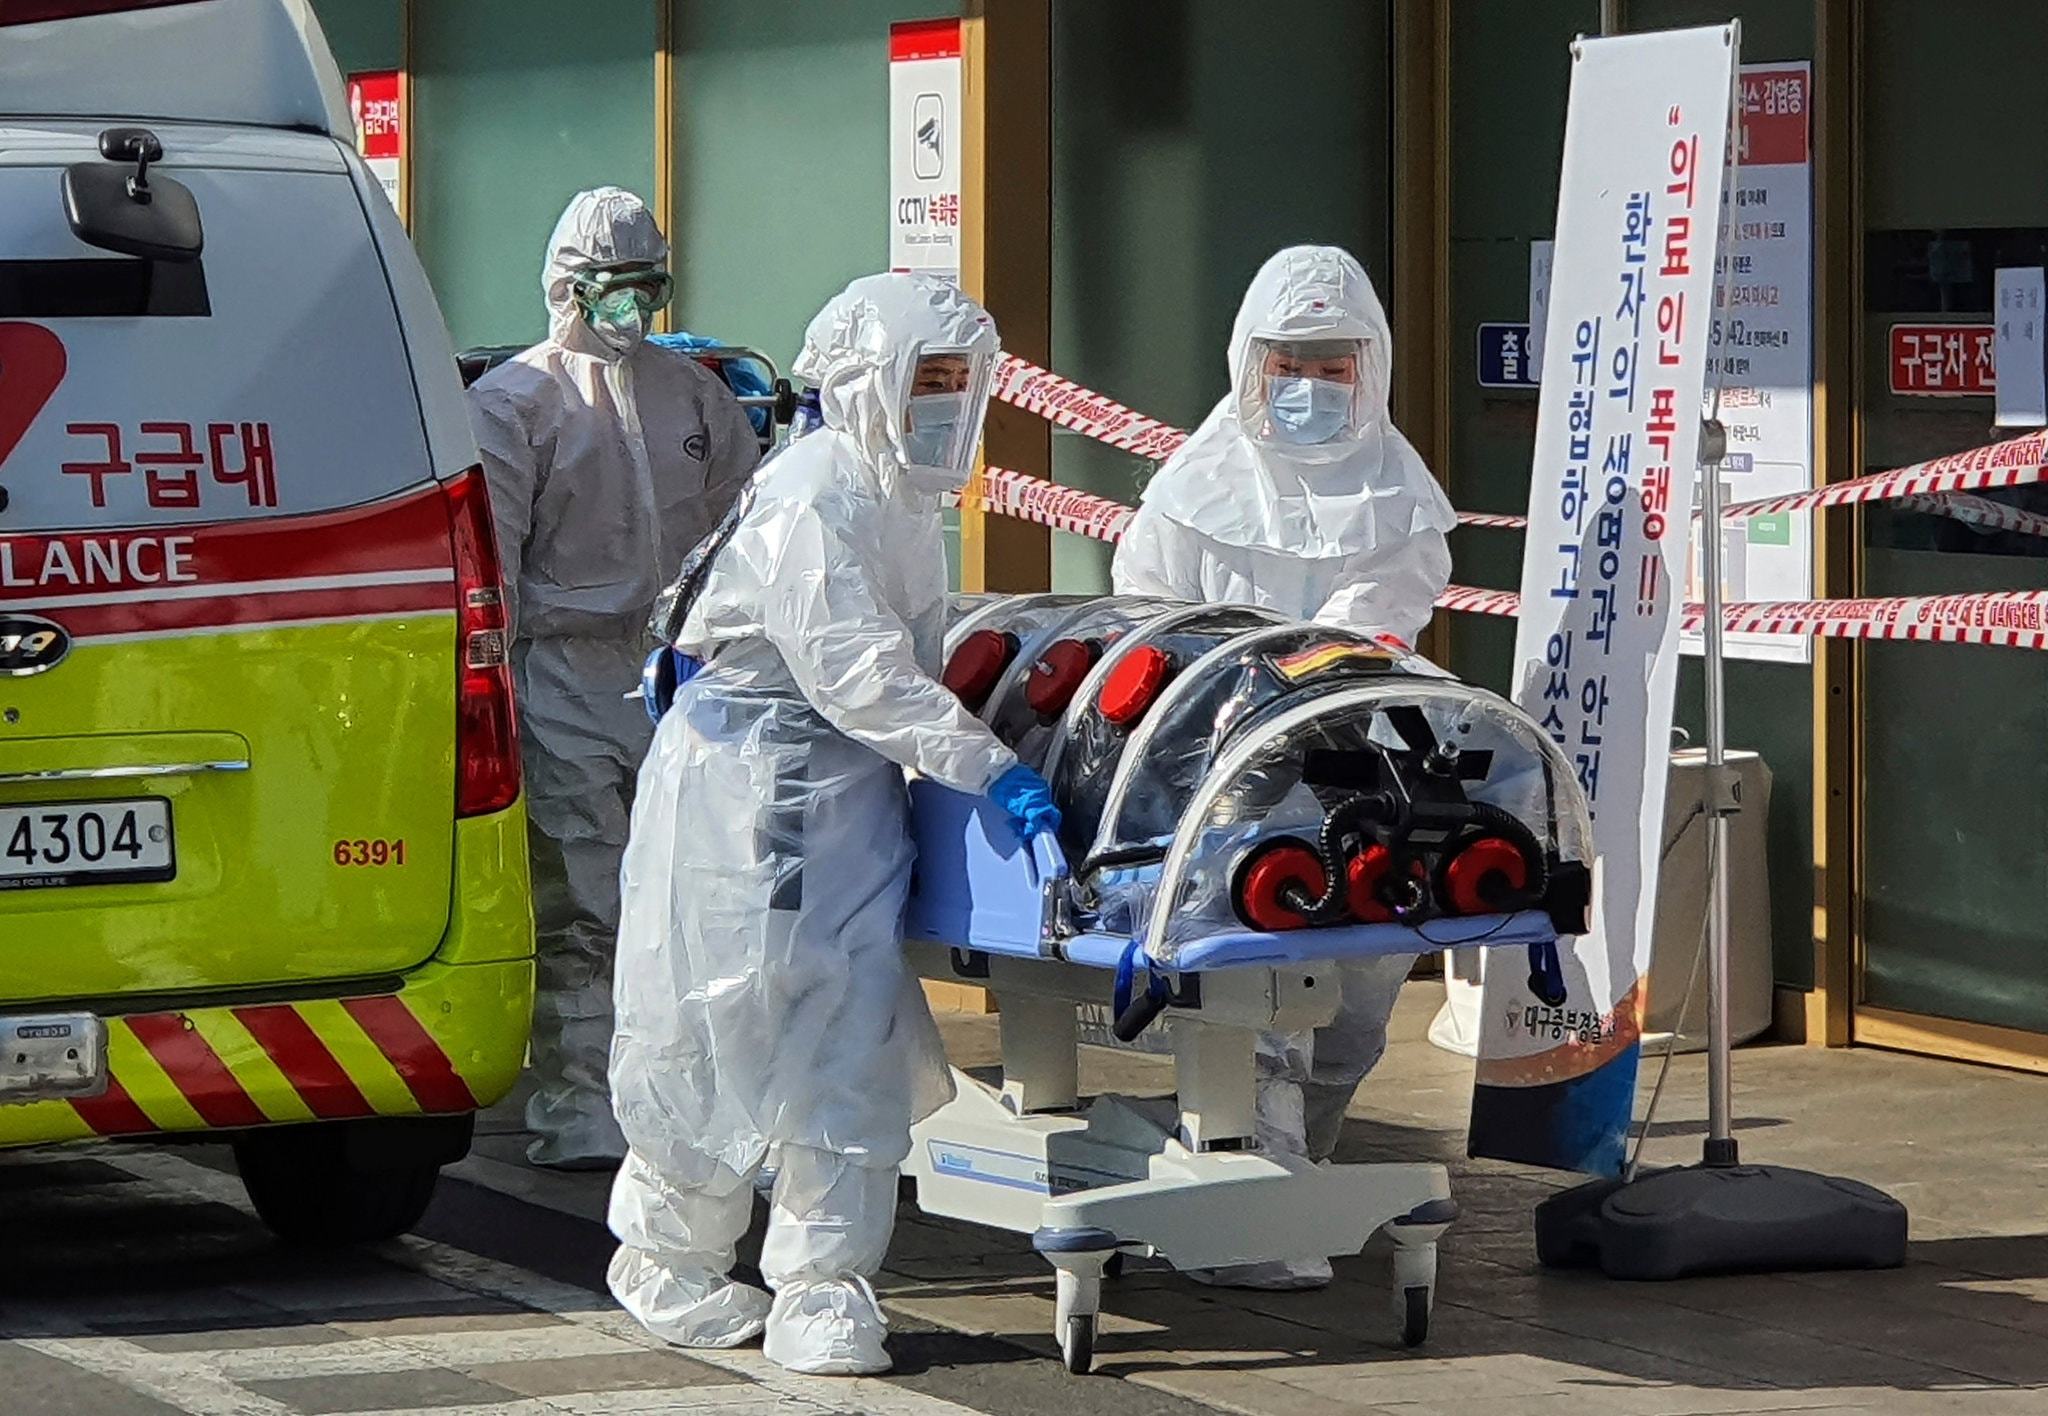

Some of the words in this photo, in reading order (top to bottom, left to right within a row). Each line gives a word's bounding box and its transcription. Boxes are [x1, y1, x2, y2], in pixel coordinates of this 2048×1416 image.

[1763, 79, 1801, 115] 감염증
[898, 197, 927, 224] CCTV
[1607, 192, 1652, 414] 환자의
[1501, 331, 1530, 380] 출
[1900, 333, 1967, 386] 구급차
[61, 422, 278, 508] 구급대
[1549, 316, 1600, 601] 위협하고
[0, 536, 198, 586] LANCE
[1585, 434, 1631, 656] 생명과
[6, 810, 143, 865] 4304
[333, 838, 406, 867] 6391
